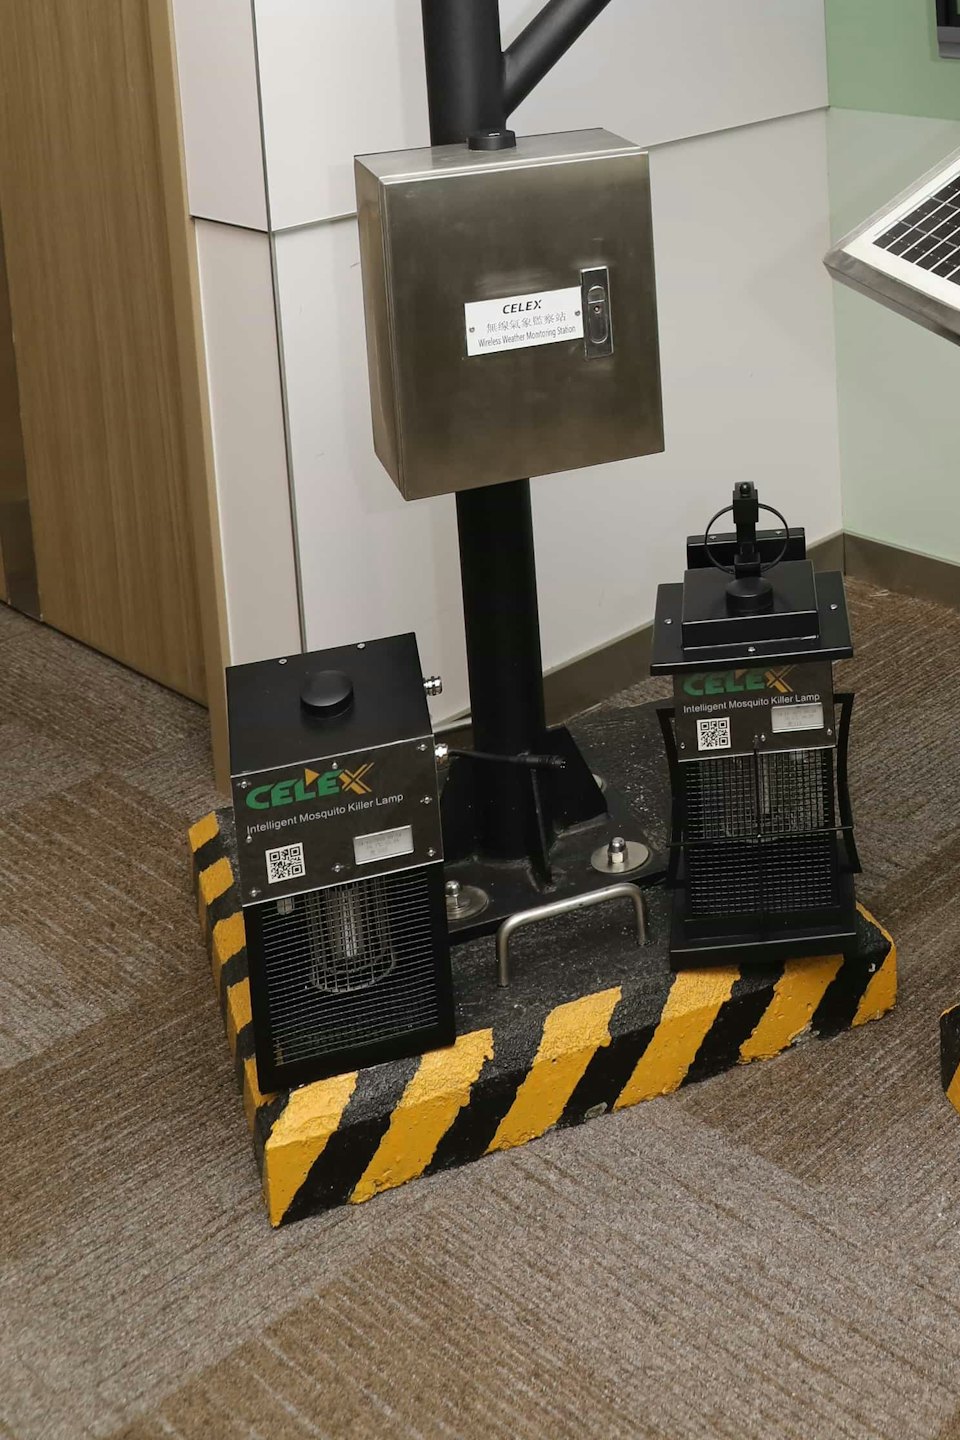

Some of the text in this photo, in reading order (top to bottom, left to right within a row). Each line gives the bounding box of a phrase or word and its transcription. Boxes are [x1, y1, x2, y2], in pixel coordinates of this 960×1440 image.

[503, 300, 542, 314] CELEX
[478, 325, 576, 347] Wireless Weather Monitoring Station
[683, 664, 796, 696] CELEX
[683, 693, 820, 713] Intelligent Mosquito Killer Lamp
[245, 762, 375, 810] CELEX
[247, 793, 403, 835] Intelligent Mosquito Killer Lamp
